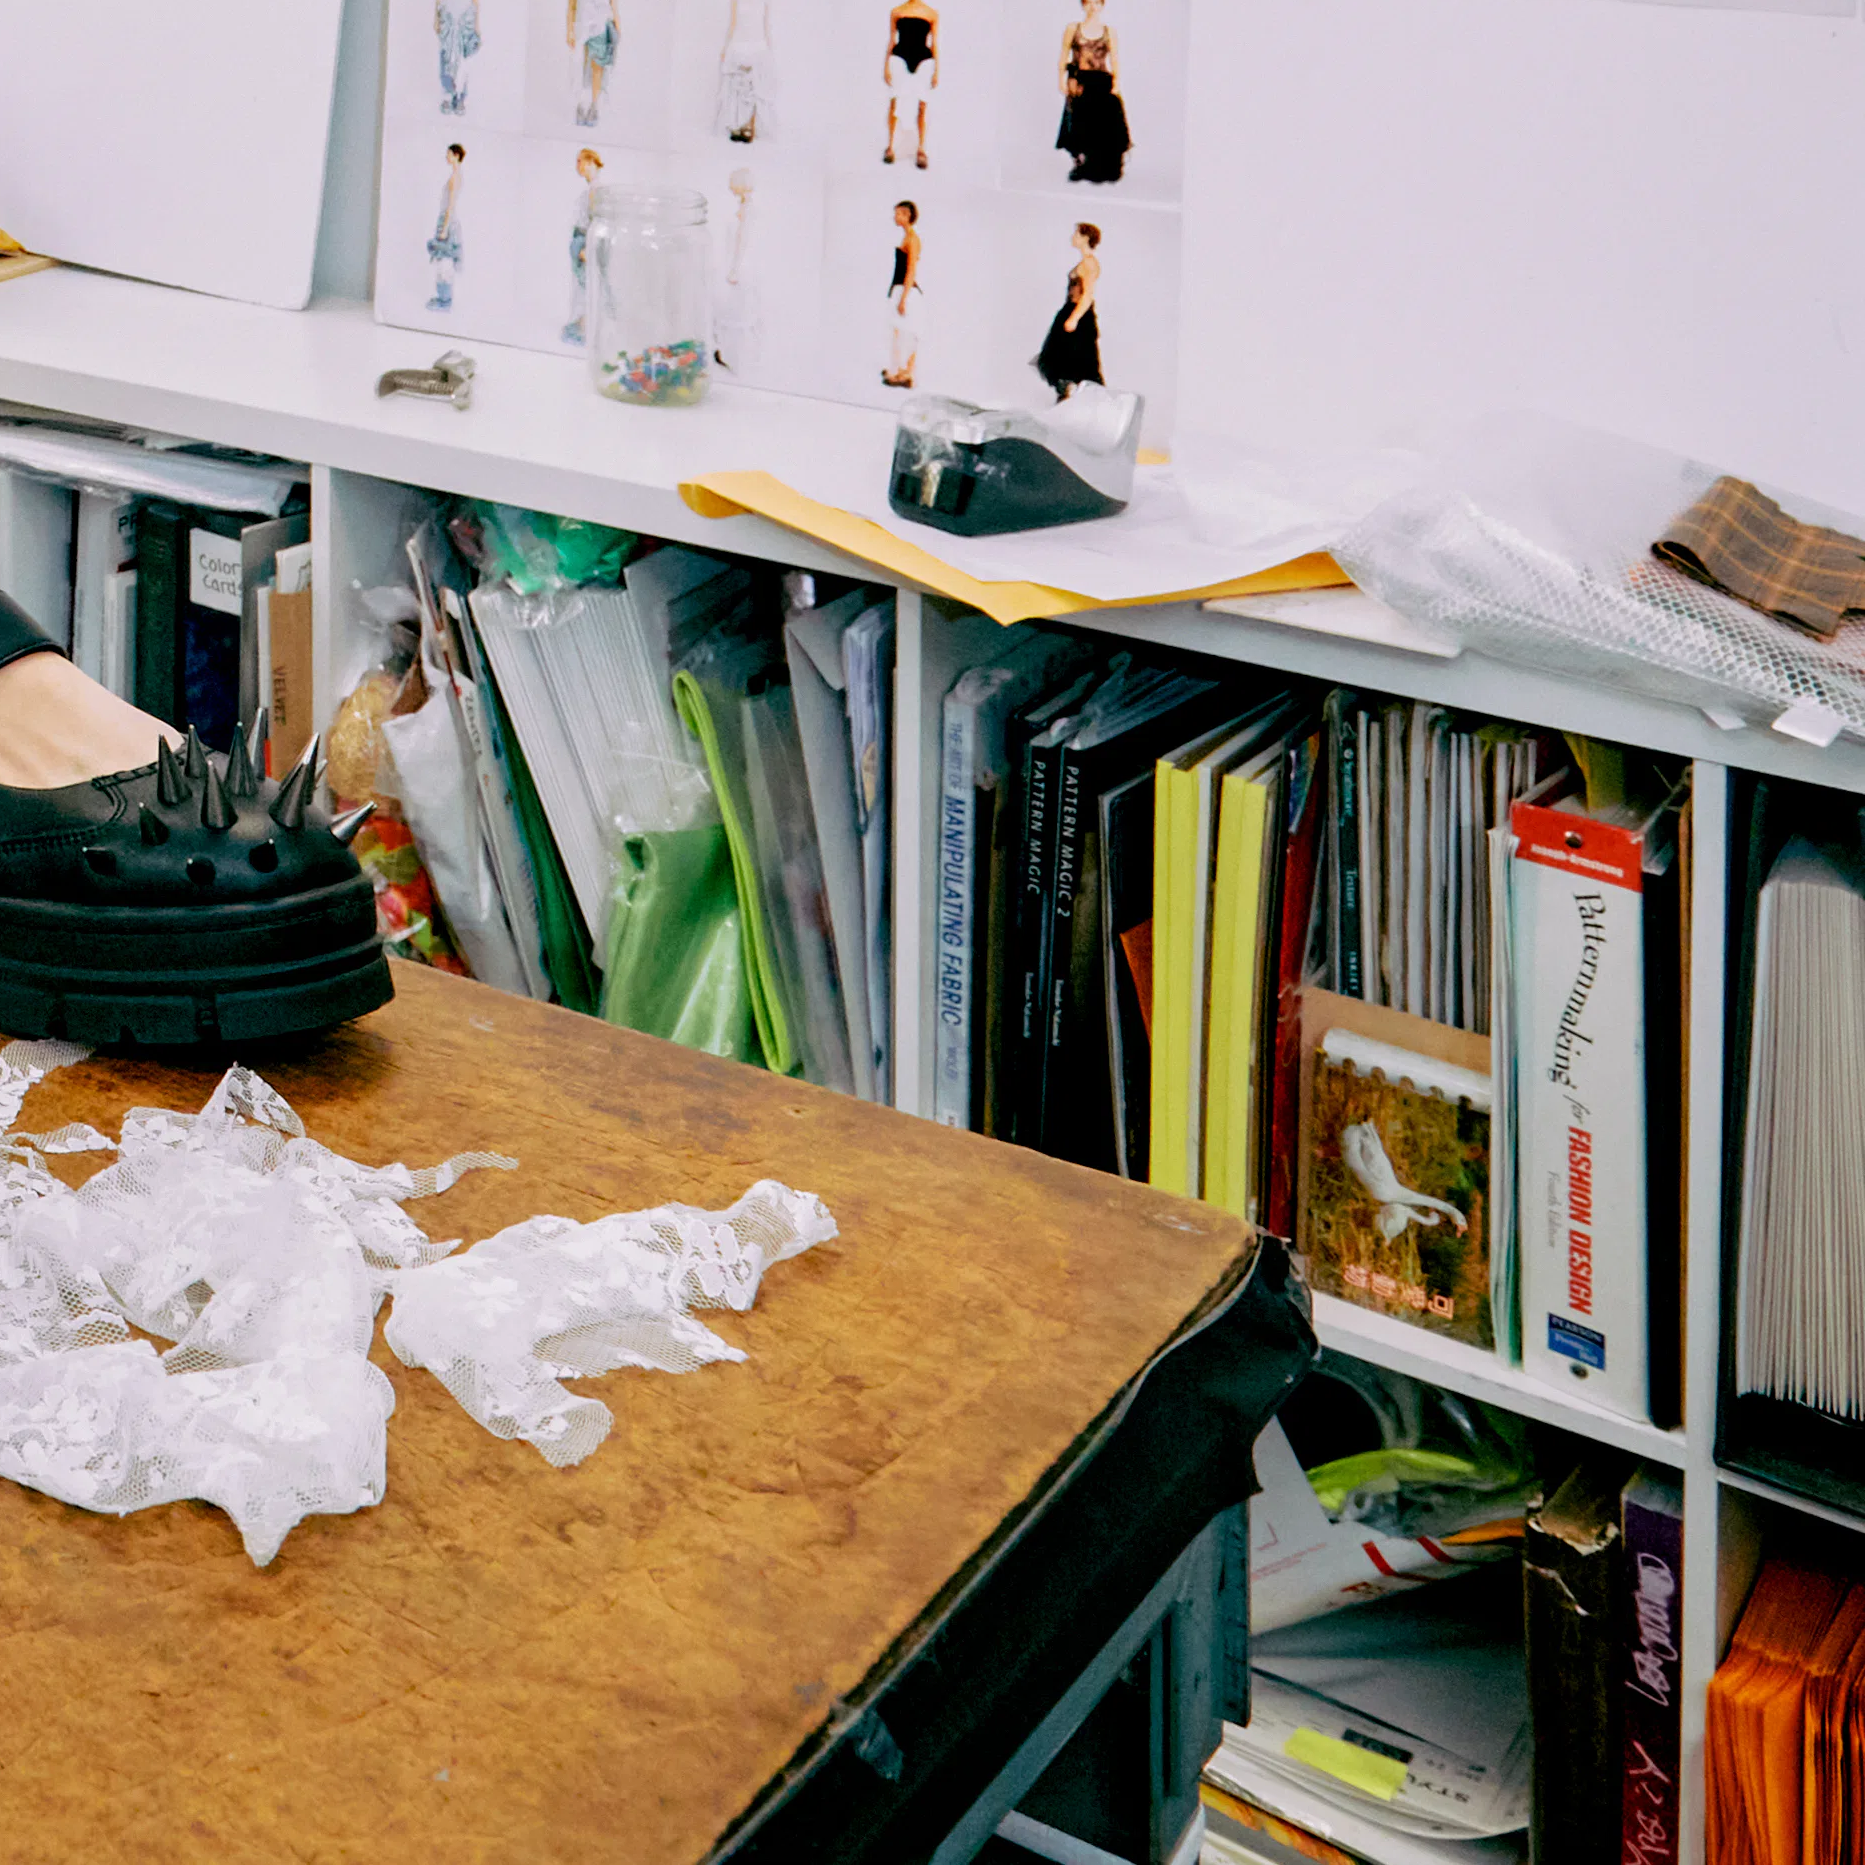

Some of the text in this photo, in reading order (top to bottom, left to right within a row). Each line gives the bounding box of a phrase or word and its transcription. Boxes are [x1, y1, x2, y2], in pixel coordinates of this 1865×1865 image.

[199, 553, 241, 576] Color
[1030, 759, 1047, 833] PATTERN
[1062, 765, 1080, 836] PATTERN
[942, 795, 966, 946] MANIPULATING
[1026, 838, 1042, 895] MAGIC
[1058, 843, 1076, 901] MAGIC
[1344, 869, 1358, 911] Texture
[1056, 906, 1071, 919] 2
[940, 952, 963, 1028] FABRIC
[1548, 892, 1607, 1317] Patternmaking for FASHION DESIGN
